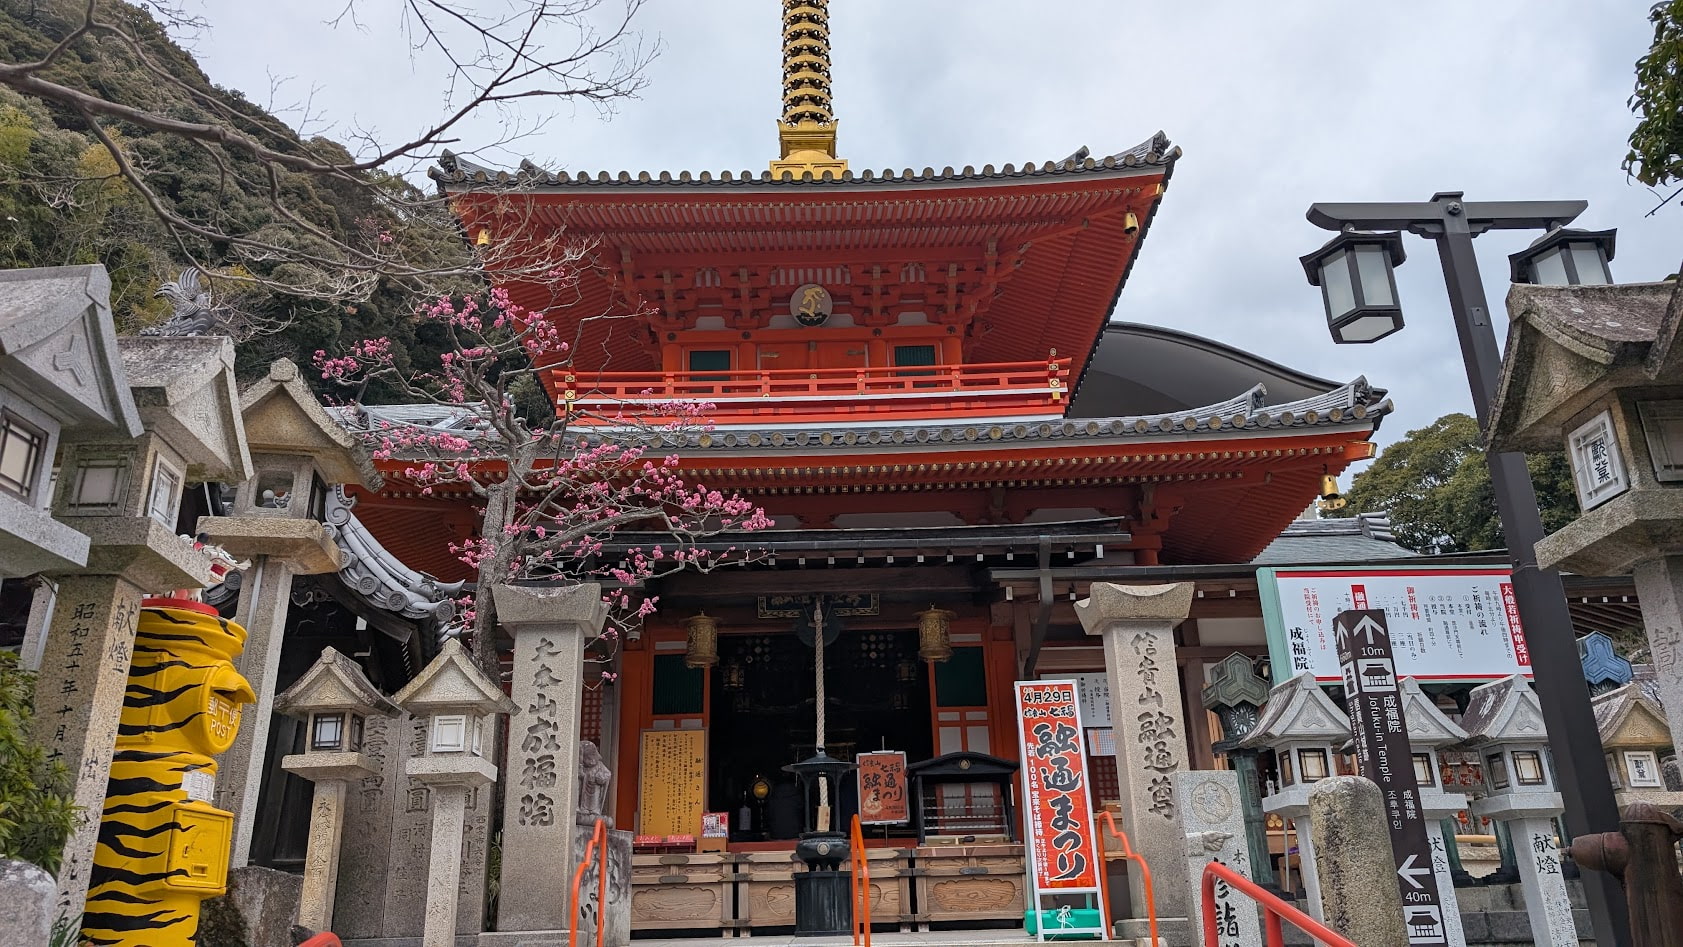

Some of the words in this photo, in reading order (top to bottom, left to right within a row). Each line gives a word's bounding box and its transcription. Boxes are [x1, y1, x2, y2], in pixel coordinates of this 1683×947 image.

[1406, 586, 1420, 620] 御祈祷料
[1472, 586, 1488, 636] ご祈祷の流れ
[1289, 627, 1309, 670] 成福院
[1361, 647, 1385, 656] 10m
[1024, 691, 1072, 703] 4月29日
[1384, 694, 1402, 733] 成福院
[210, 719, 232, 738] POST
[1131, 631, 1180, 820] 信貴山融通尊
[1368, 695, 1384, 742] Jofuku-in
[1378, 744, 1393, 782] Temple
[1033, 722, 1087, 880] 融通まつり
[1403, 789, 1418, 820] 成福院
[1532, 833, 1560, 875] 献燈
[1405, 892, 1431, 902] 40m
